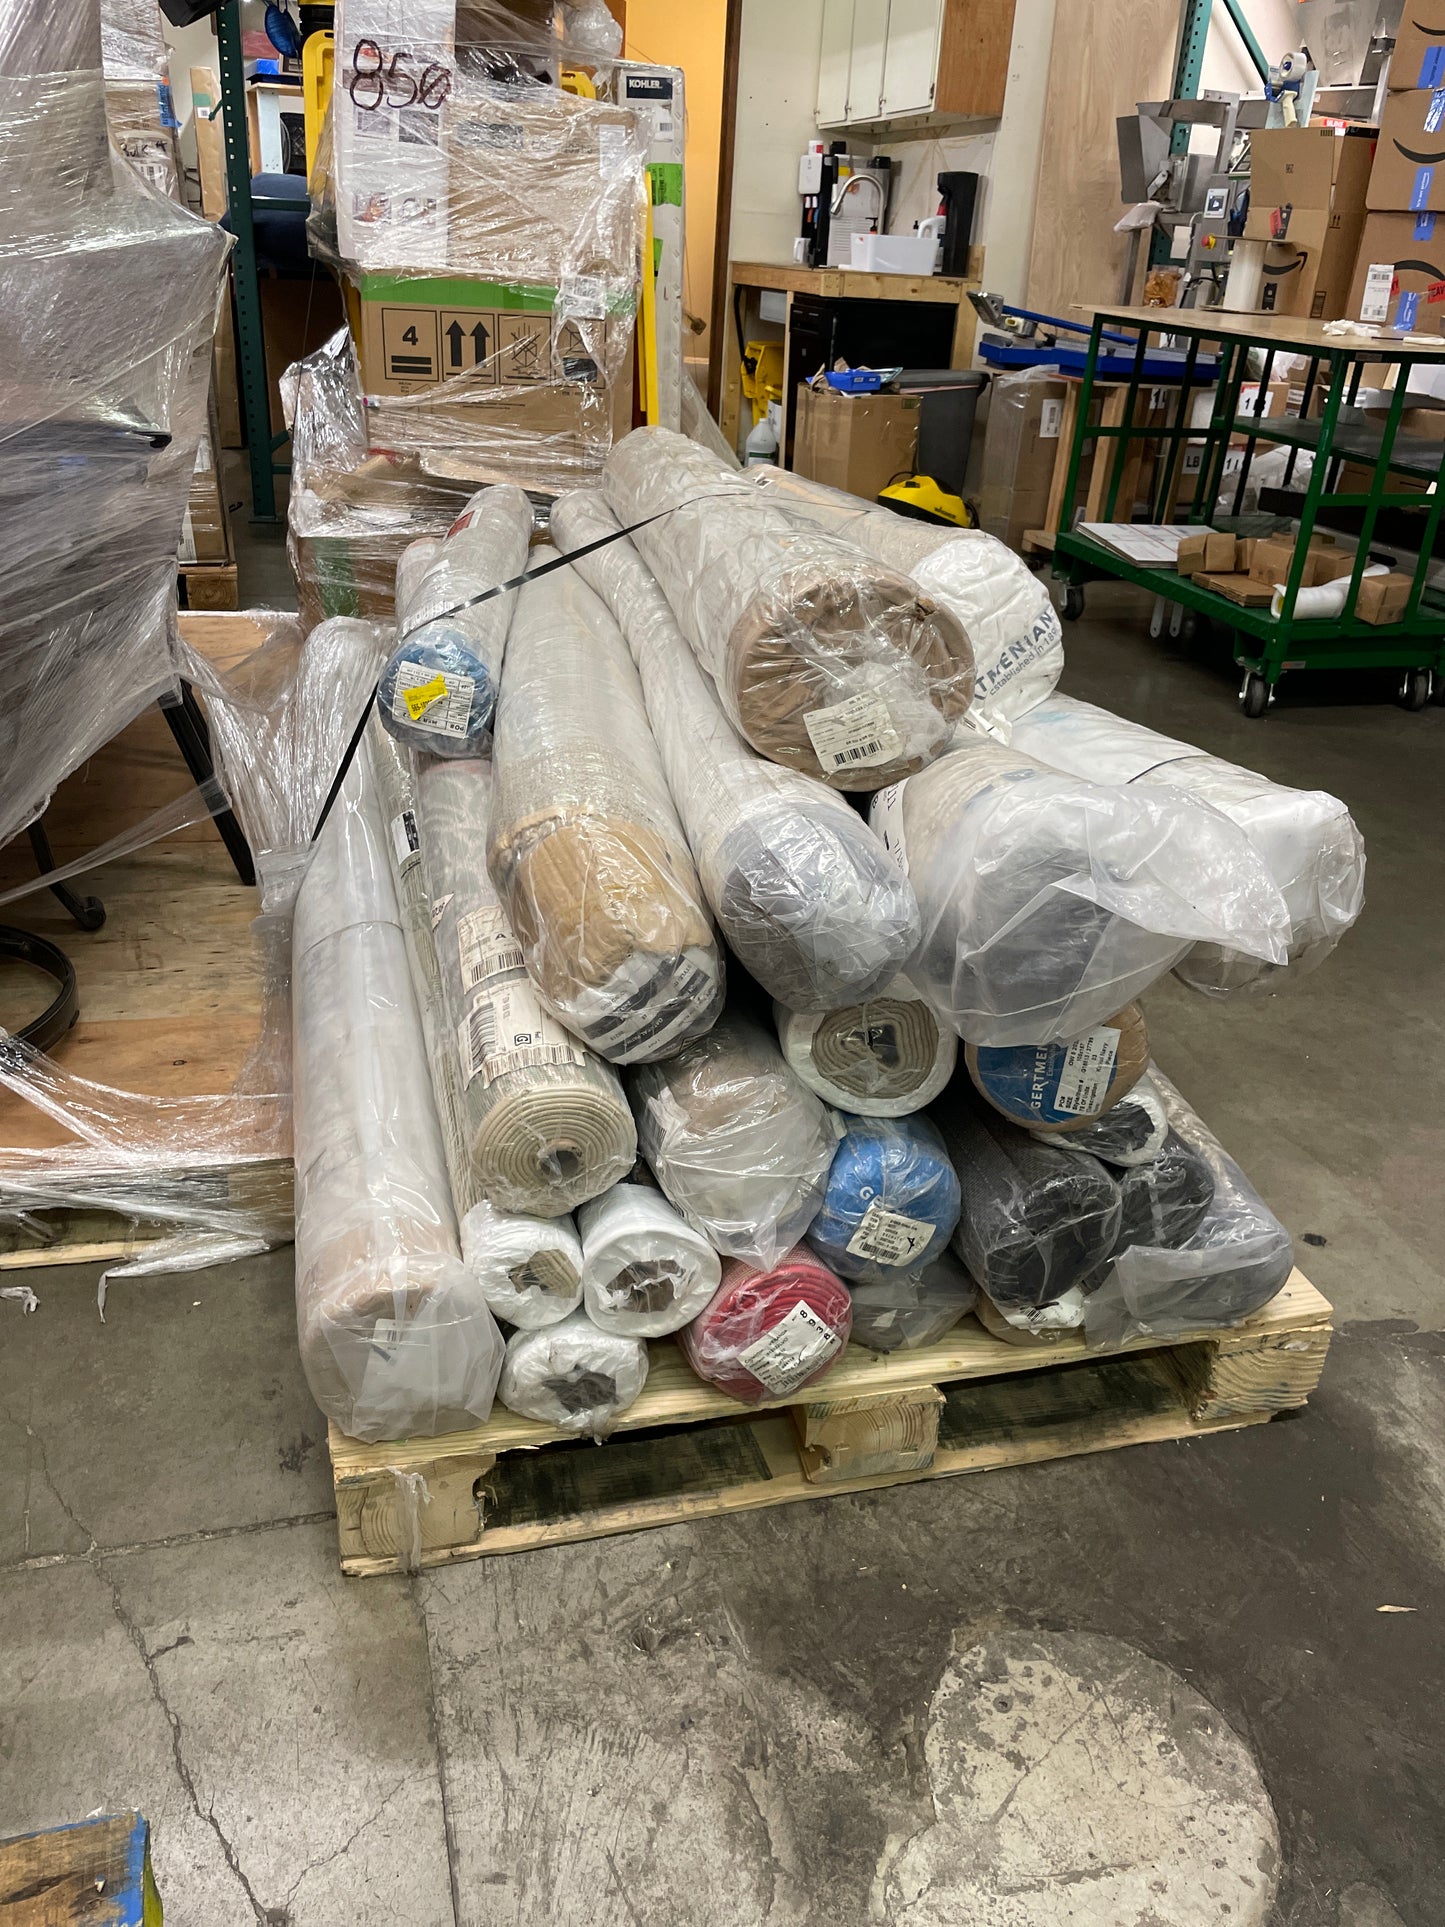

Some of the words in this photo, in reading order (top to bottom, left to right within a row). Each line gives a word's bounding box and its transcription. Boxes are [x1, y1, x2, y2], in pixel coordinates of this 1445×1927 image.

[349, 38, 452, 111] 850
[629, 80, 662, 88] KOHLER
[402, 326, 418, 345] 4
[1186, 456, 1200, 467] LB
